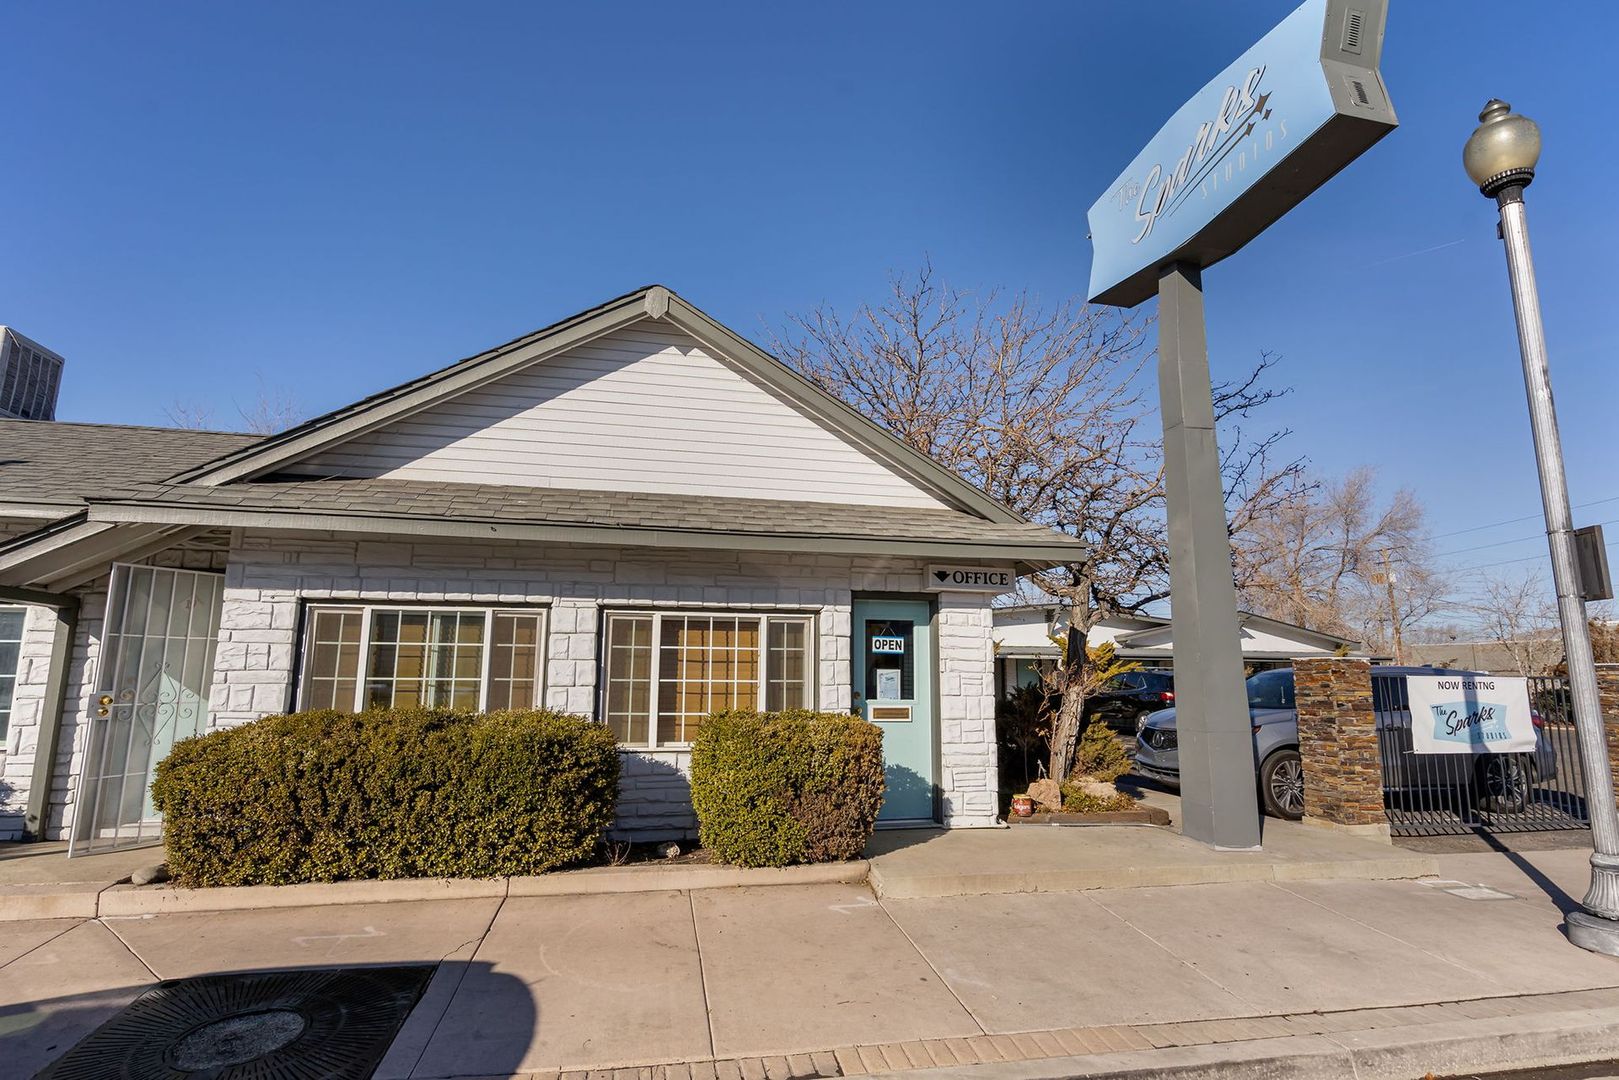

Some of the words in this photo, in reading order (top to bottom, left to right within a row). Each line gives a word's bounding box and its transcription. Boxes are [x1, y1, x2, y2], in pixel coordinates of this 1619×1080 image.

[1131, 64, 1266, 244] Sparks
[1201, 119, 1287, 199] STUDIOS
[953, 570, 1009, 586] OFFICE
[874, 639, 903, 650] OPEN
[1438, 681, 1460, 690] NOW
[1432, 705, 1447, 716] The
[1446, 706, 1496, 736] Sparks
